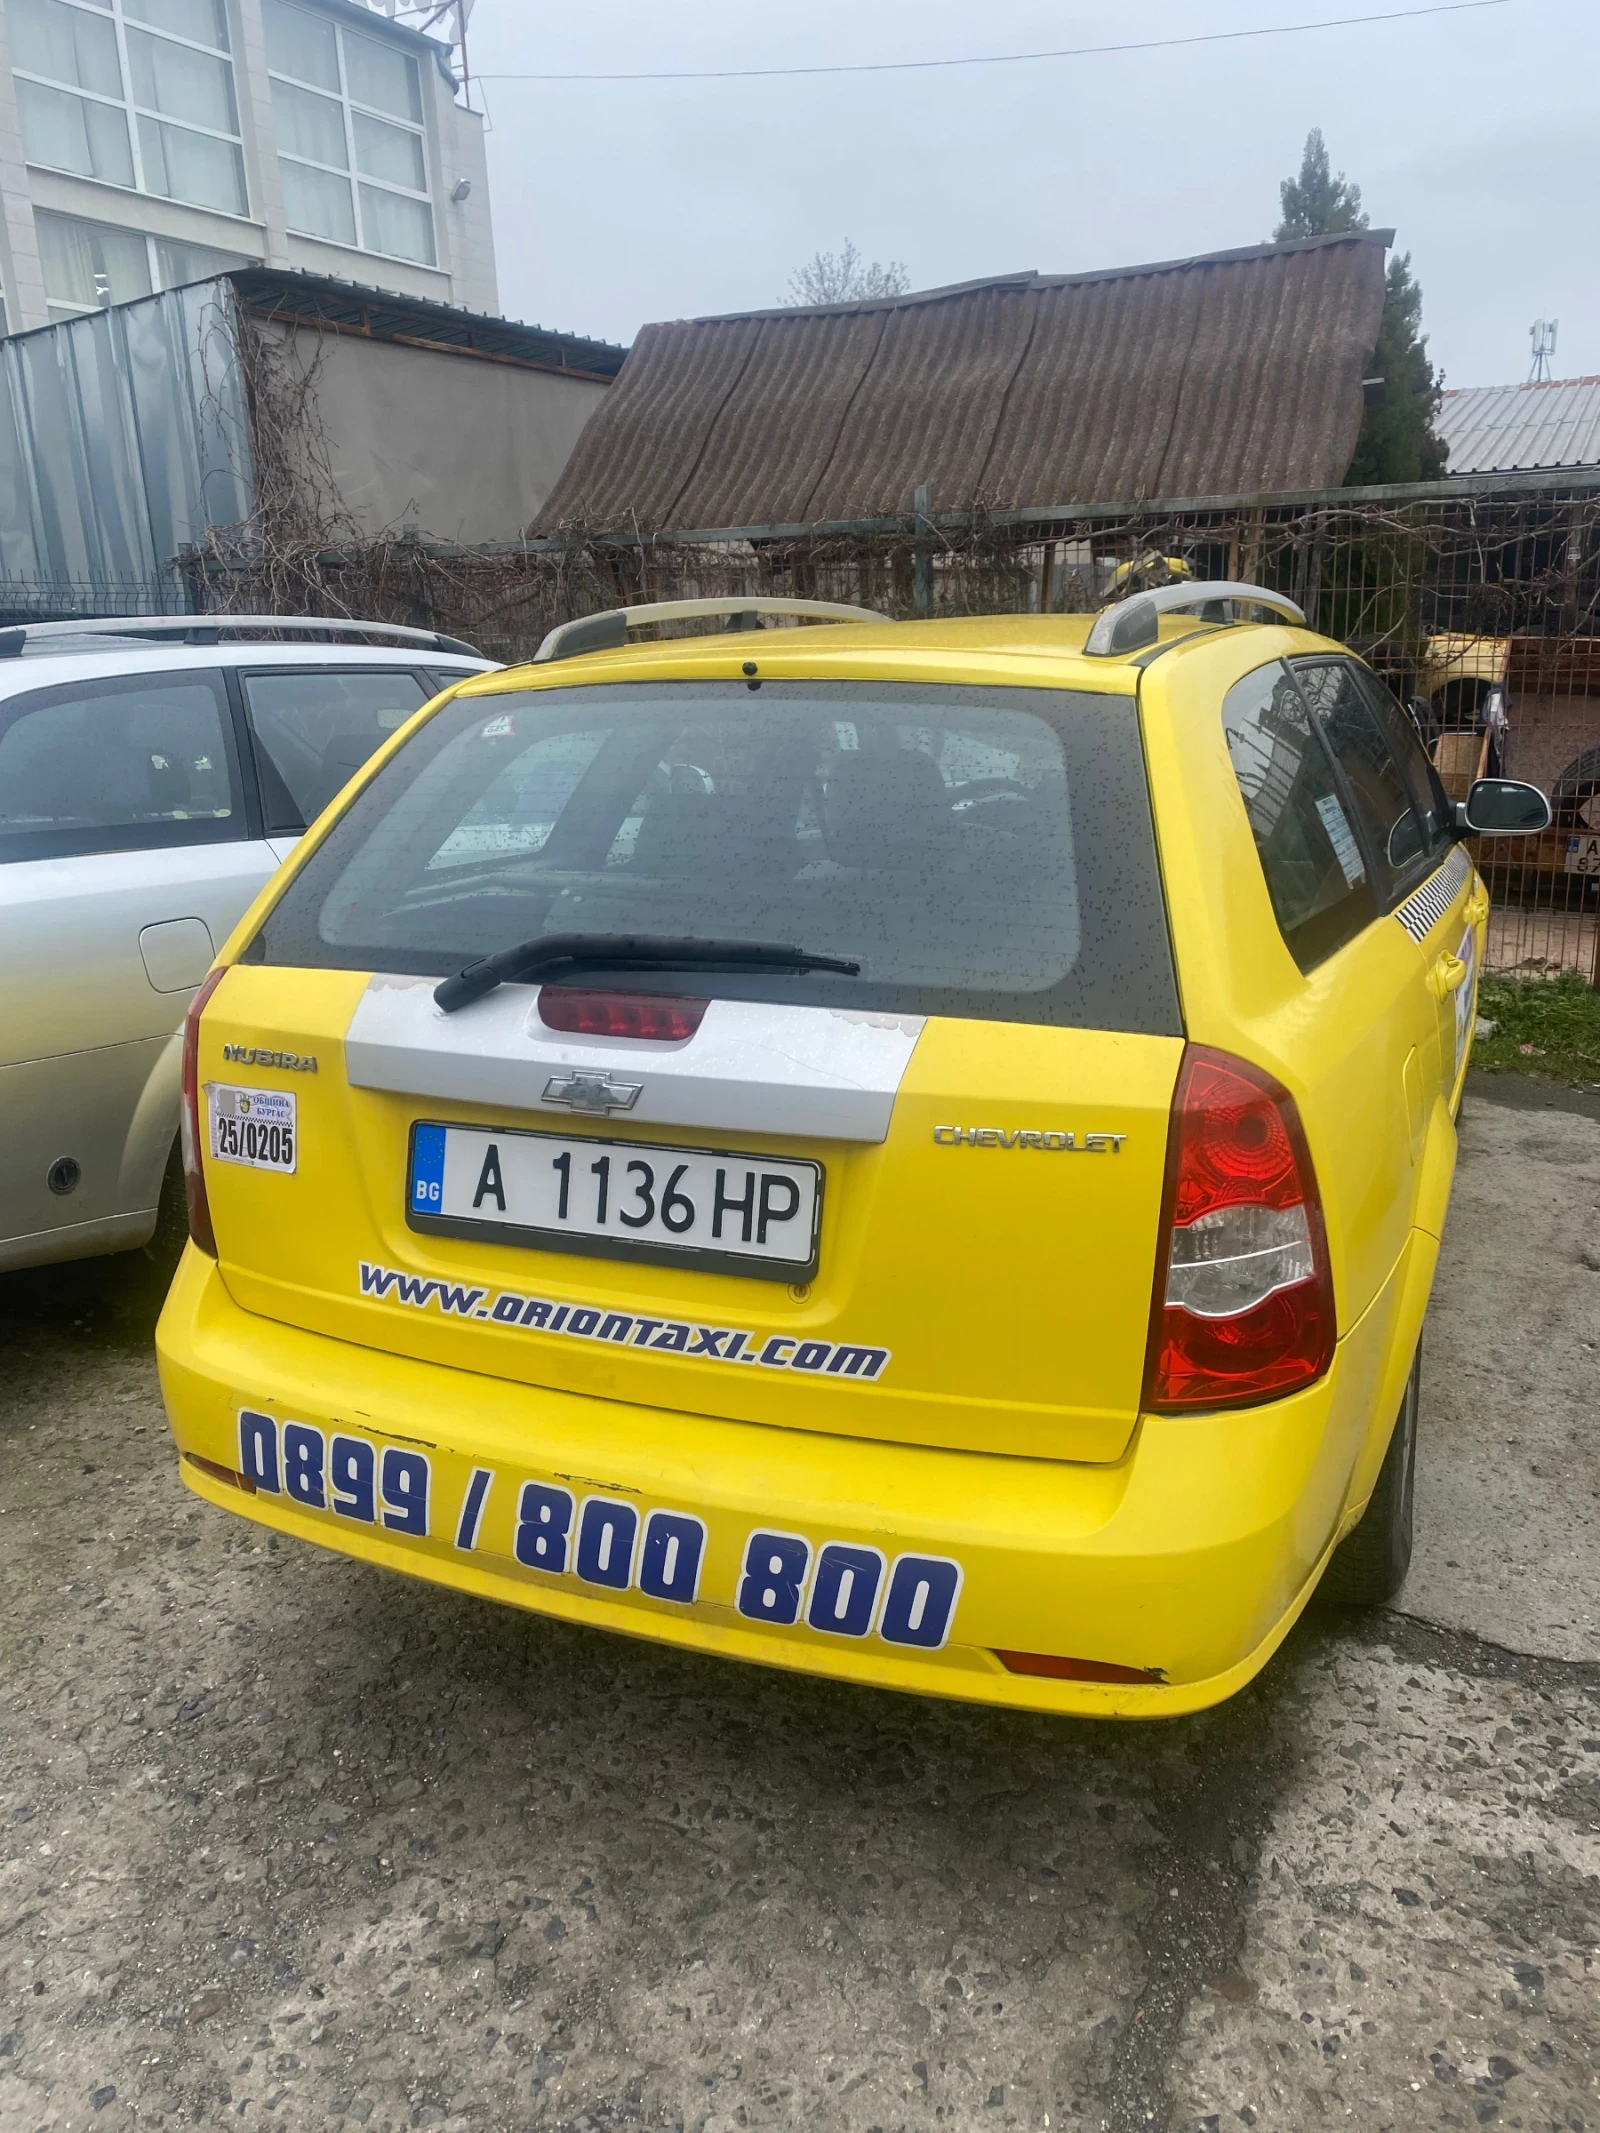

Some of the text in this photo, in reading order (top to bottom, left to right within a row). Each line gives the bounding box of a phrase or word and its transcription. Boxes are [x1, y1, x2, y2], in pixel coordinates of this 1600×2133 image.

[1586, 839, 1599, 856] A
[222, 1042, 318, 1074] NUBIRA
[253, 1095, 290, 1108] ОБЩИНА
[256, 1108, 285, 1118] БУРГАС
[218, 1117, 293, 1165] 25/0205
[933, 1125, 1127, 1153] CHEVROLET
[416, 1180, 440, 1201] BG
[472, 1144, 801, 1244] A 1136 HP
[239, 1409, 430, 1537] 0899
[515, 1482, 703, 1603] 800
[738, 1531, 963, 1648] 800
